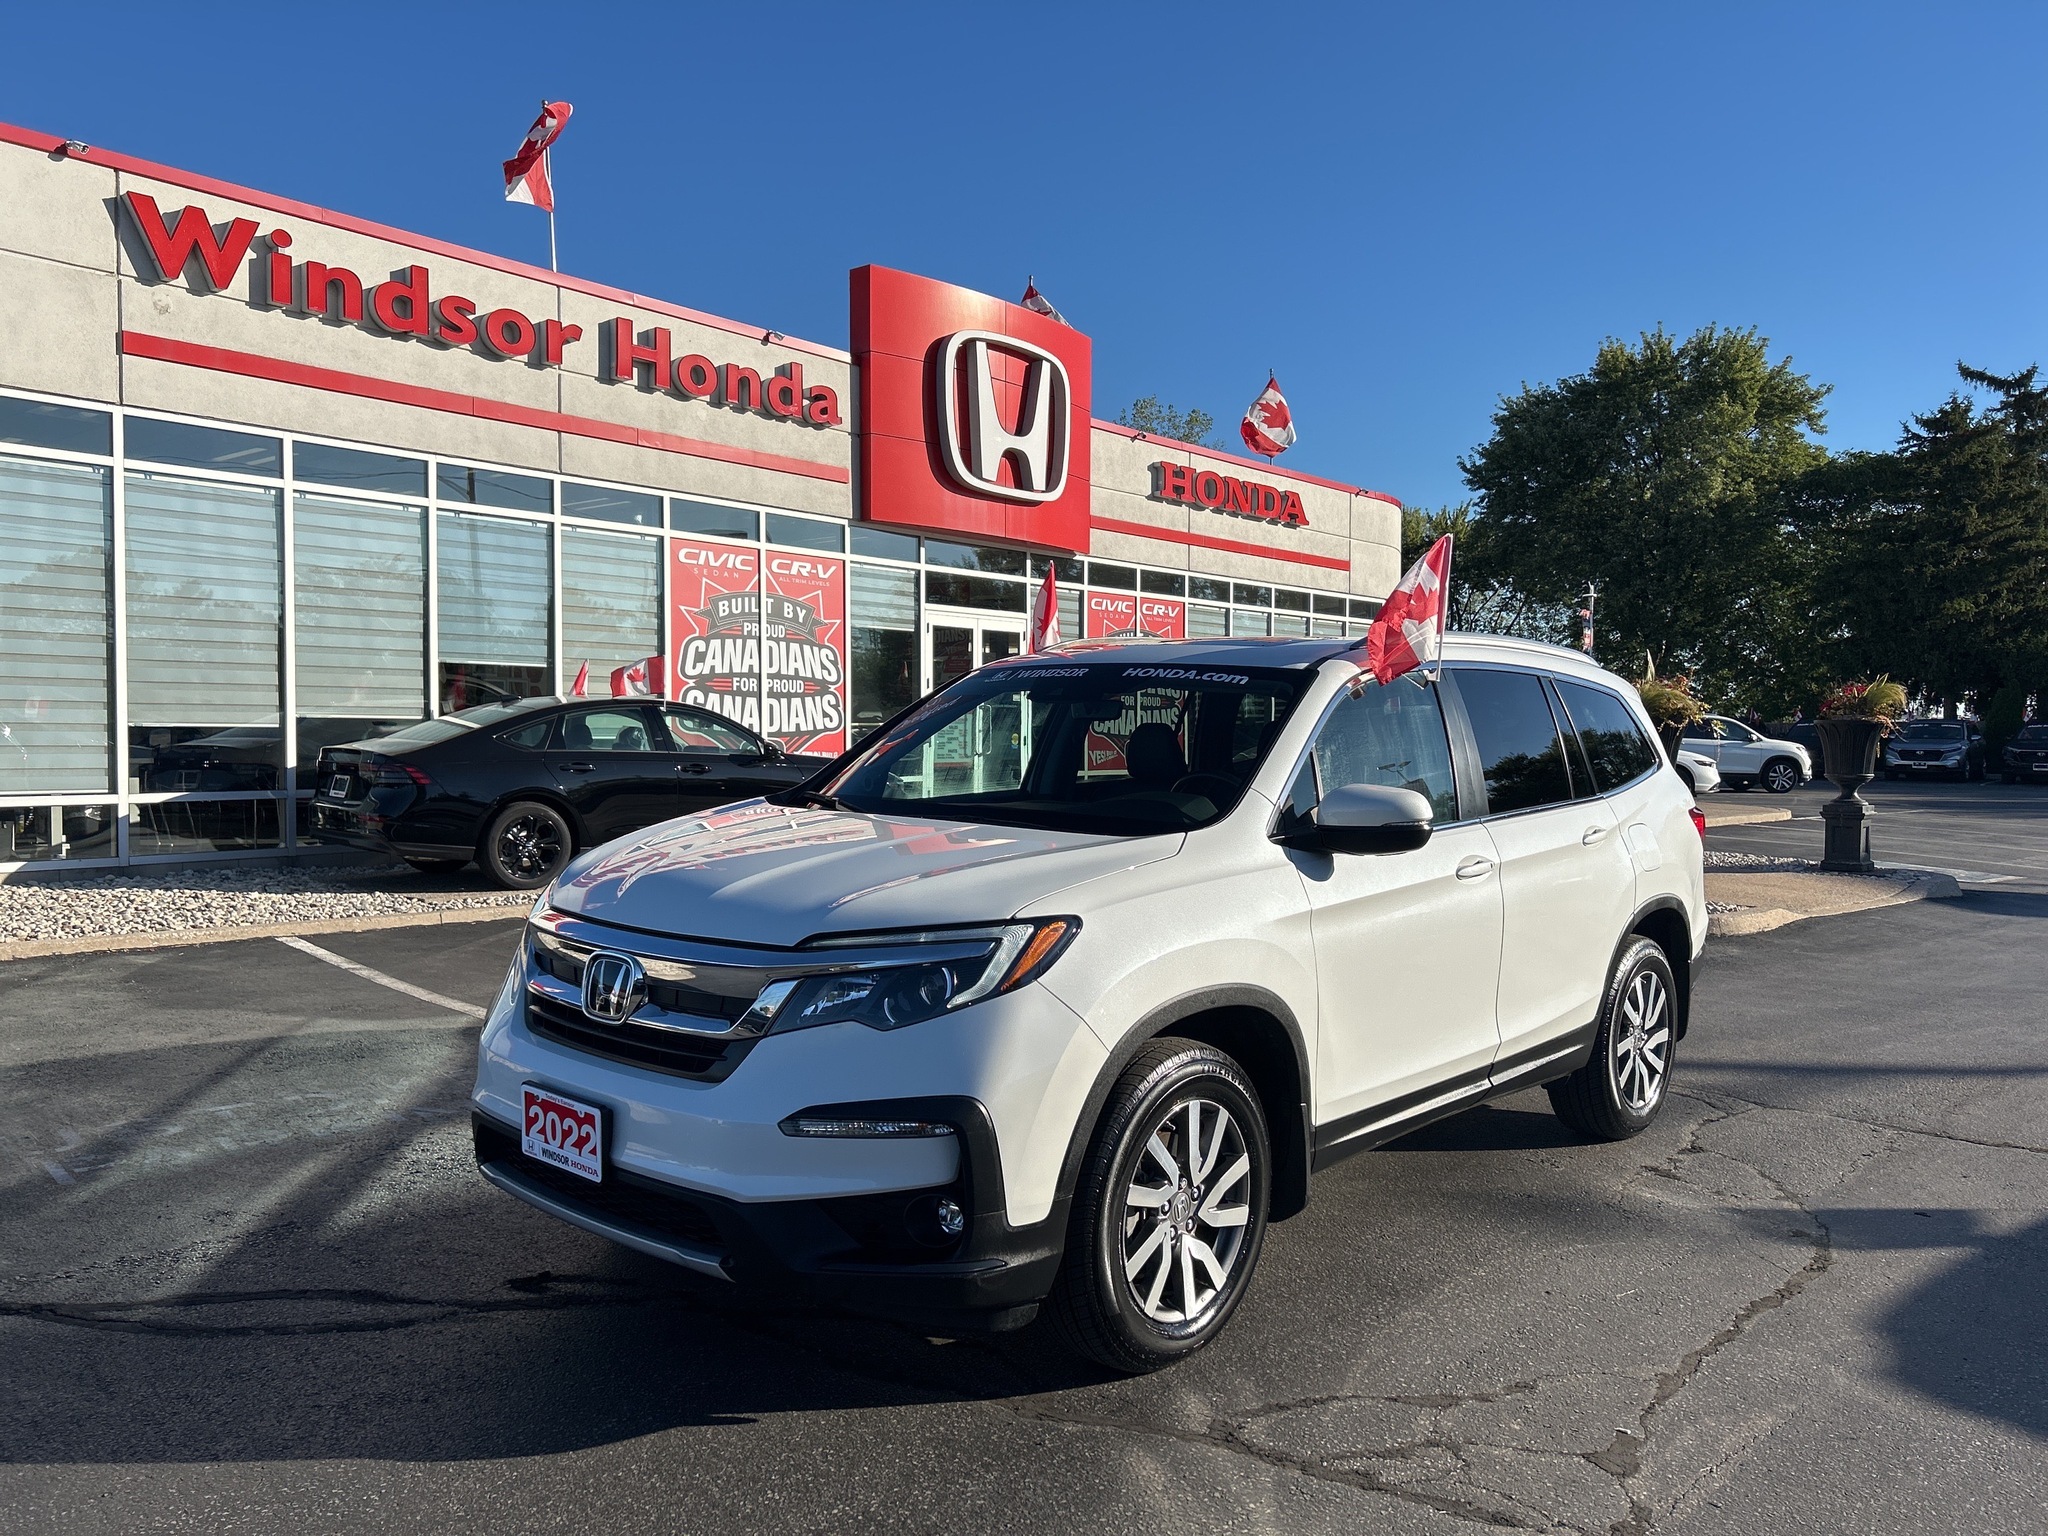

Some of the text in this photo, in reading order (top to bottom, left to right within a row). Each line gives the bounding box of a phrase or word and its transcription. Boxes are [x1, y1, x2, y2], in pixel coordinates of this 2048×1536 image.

[124, 189, 843, 427] Windsor Honda
[1157, 460, 1310, 527] HONDA
[678, 547, 755, 571] CIVIC
[693, 567, 740, 579] SEDAN
[771, 558, 837, 579] CR-V
[792, 577, 808, 585] TRIM
[808, 579, 830, 587] LEVELS
[718, 597, 806, 623] BUILT BY
[1091, 598, 1133, 613] CIVIC
[1142, 602, 1180, 617] CR-V
[1099, 612, 1125, 620] SEDAN
[743, 622, 786, 638] PROUD
[684, 638, 838, 683] CANADIANS
[732, 677, 805, 693] FOR PROUD
[1020, 667, 1250, 685] WINDSOR HONDA.com
[1120, 695, 1162, 707] FOR PROUD
[528, 1104, 597, 1159] 2022
[541, 1147, 570, 1167] WINDSOR
[570, 1160, 599, 1177] HONDA
